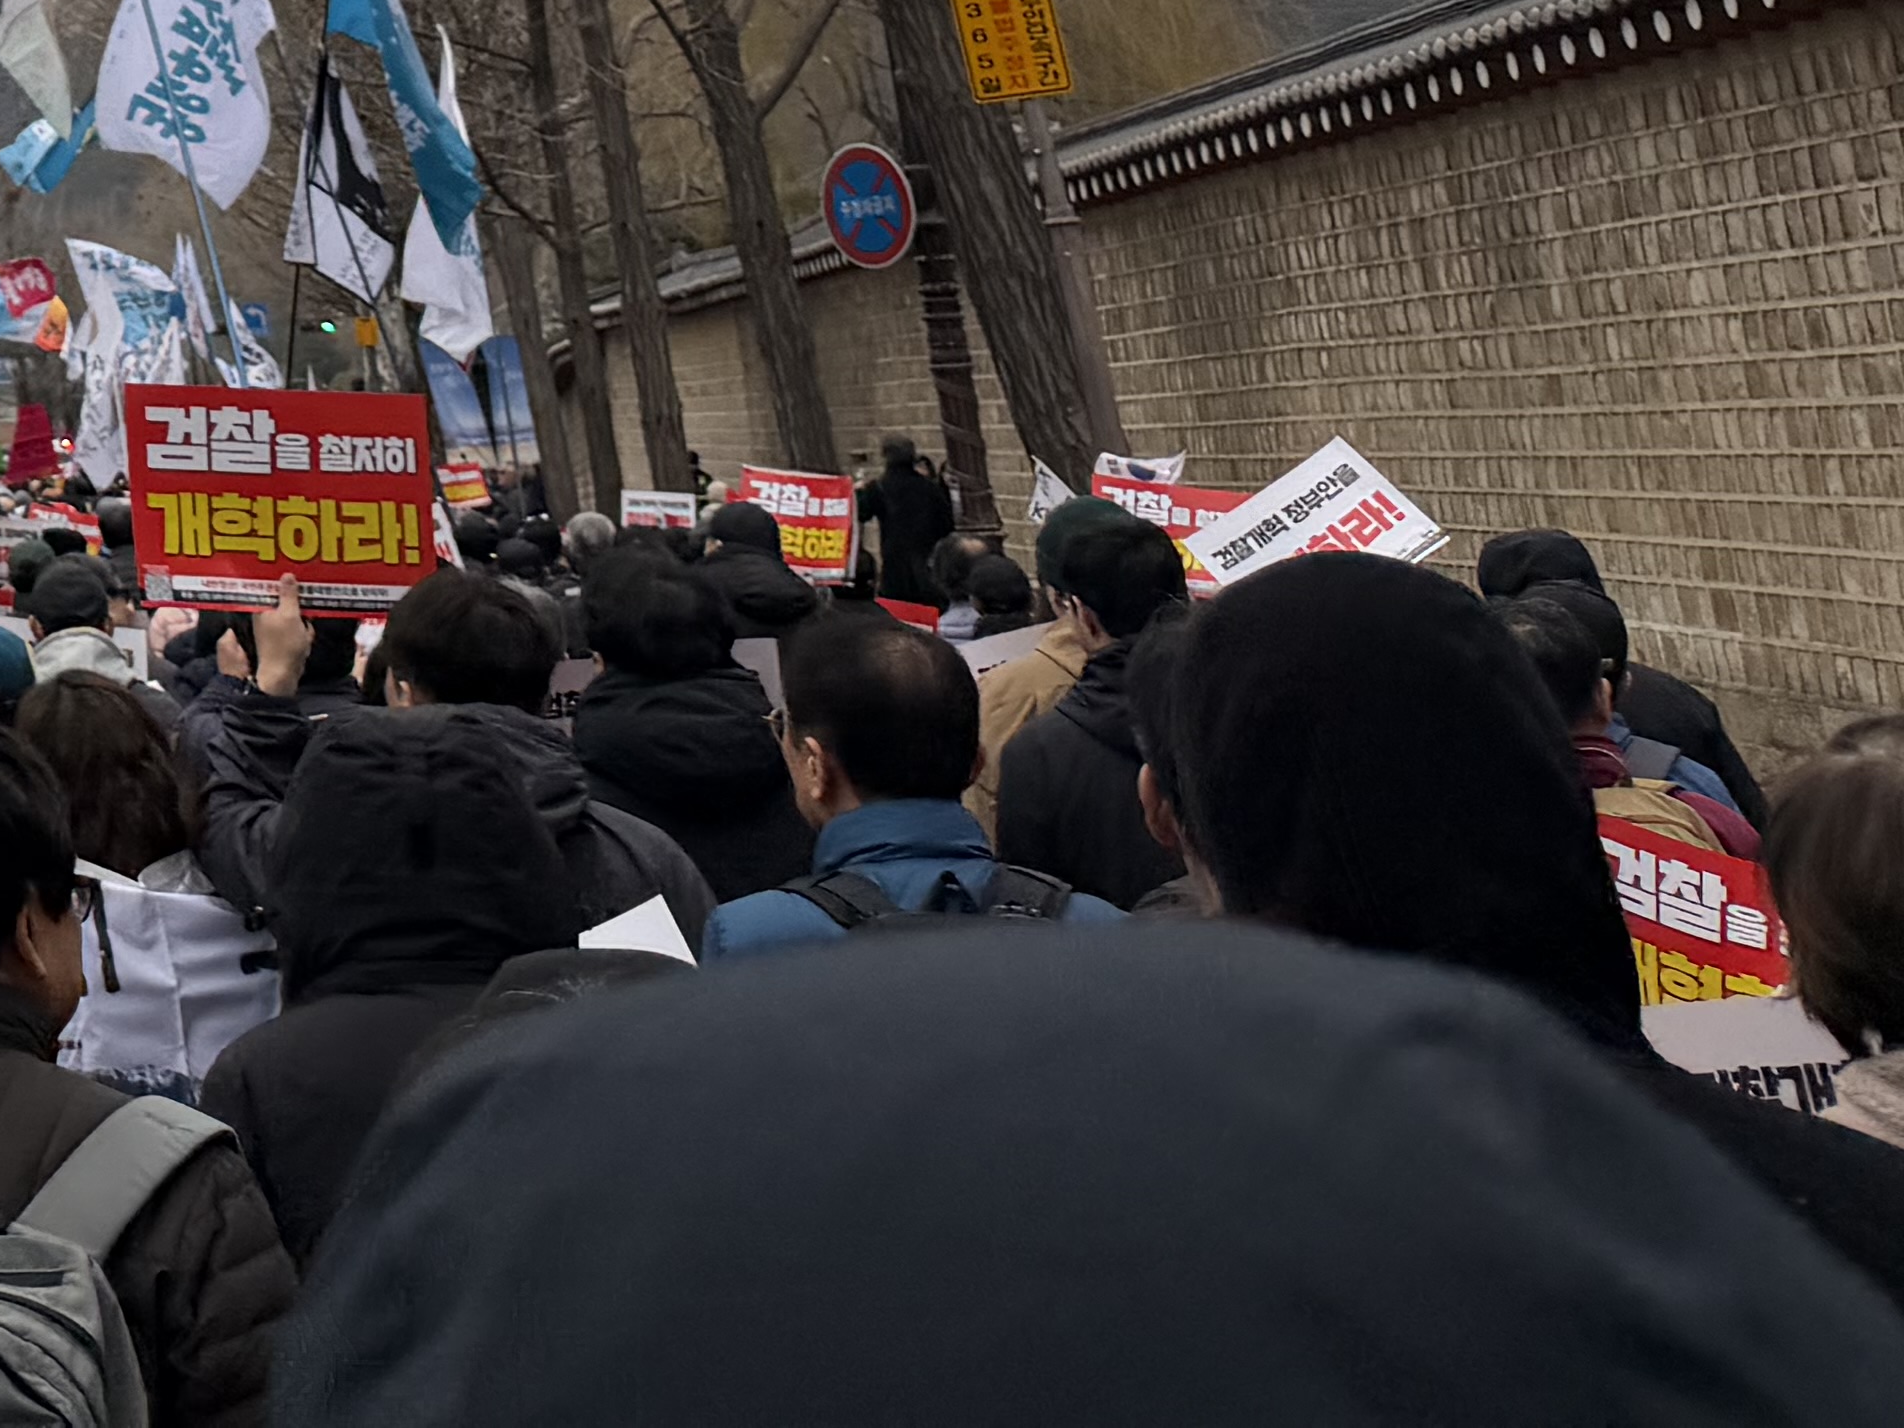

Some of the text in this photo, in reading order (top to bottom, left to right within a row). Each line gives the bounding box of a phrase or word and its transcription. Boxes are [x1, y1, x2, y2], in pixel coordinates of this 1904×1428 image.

[144, 405, 418, 475] 검찰을 철저히
[145, 491, 422, 565] 개혁하라!
[1210, 515, 1293, 573] 검찰개혁
[1280, 462, 1362, 526] 정부안을
[1294, 488, 1408, 556] 하라!
[1600, 835, 1768, 950] 검찰을
